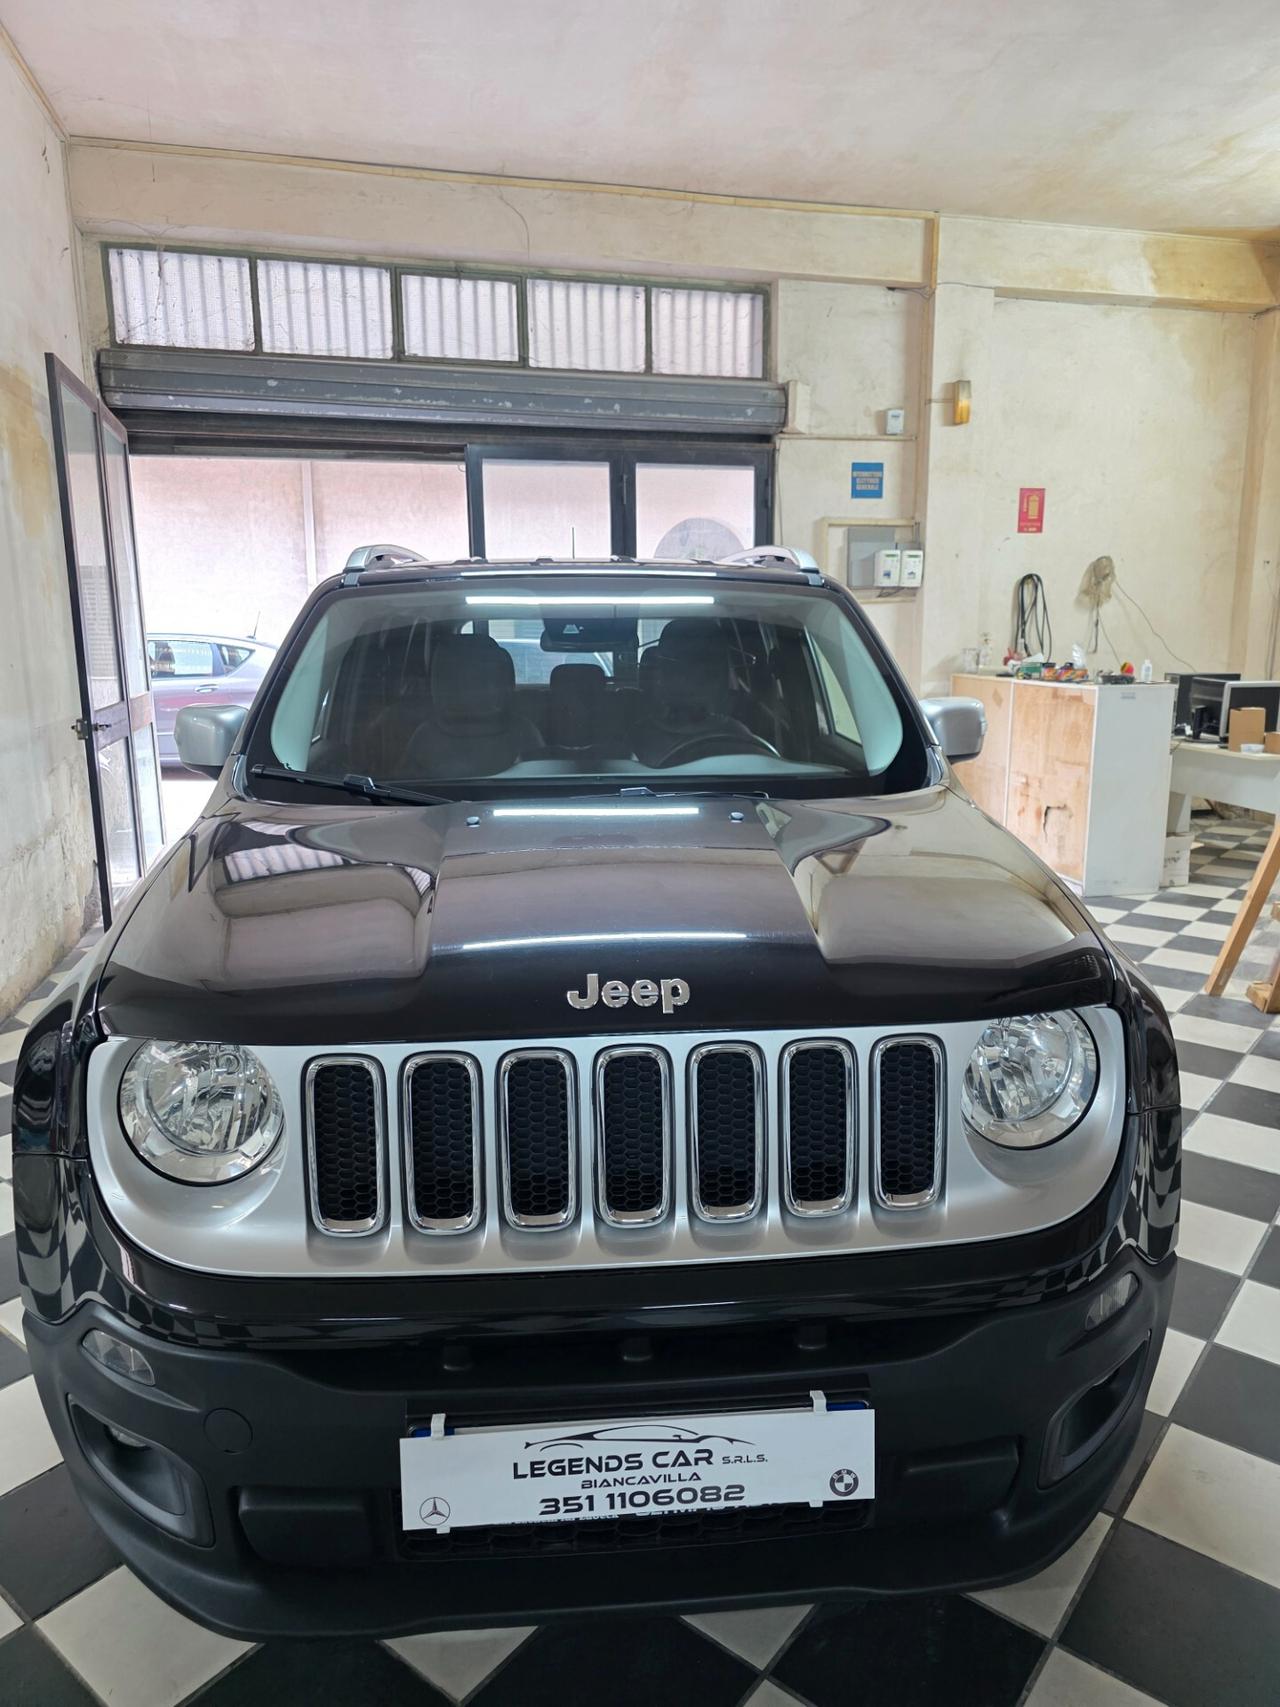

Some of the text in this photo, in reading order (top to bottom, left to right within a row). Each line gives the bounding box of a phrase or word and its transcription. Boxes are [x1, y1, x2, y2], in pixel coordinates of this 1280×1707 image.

[567, 973, 690, 1014] Jeep
[513, 1448, 768, 1480] LEGENDS CAR S.R.L.S.
[581, 1471, 702, 1490] BIANCAVILLA
[538, 1494, 595, 1516] 351
[605, 1484, 746, 1511] 1106082
